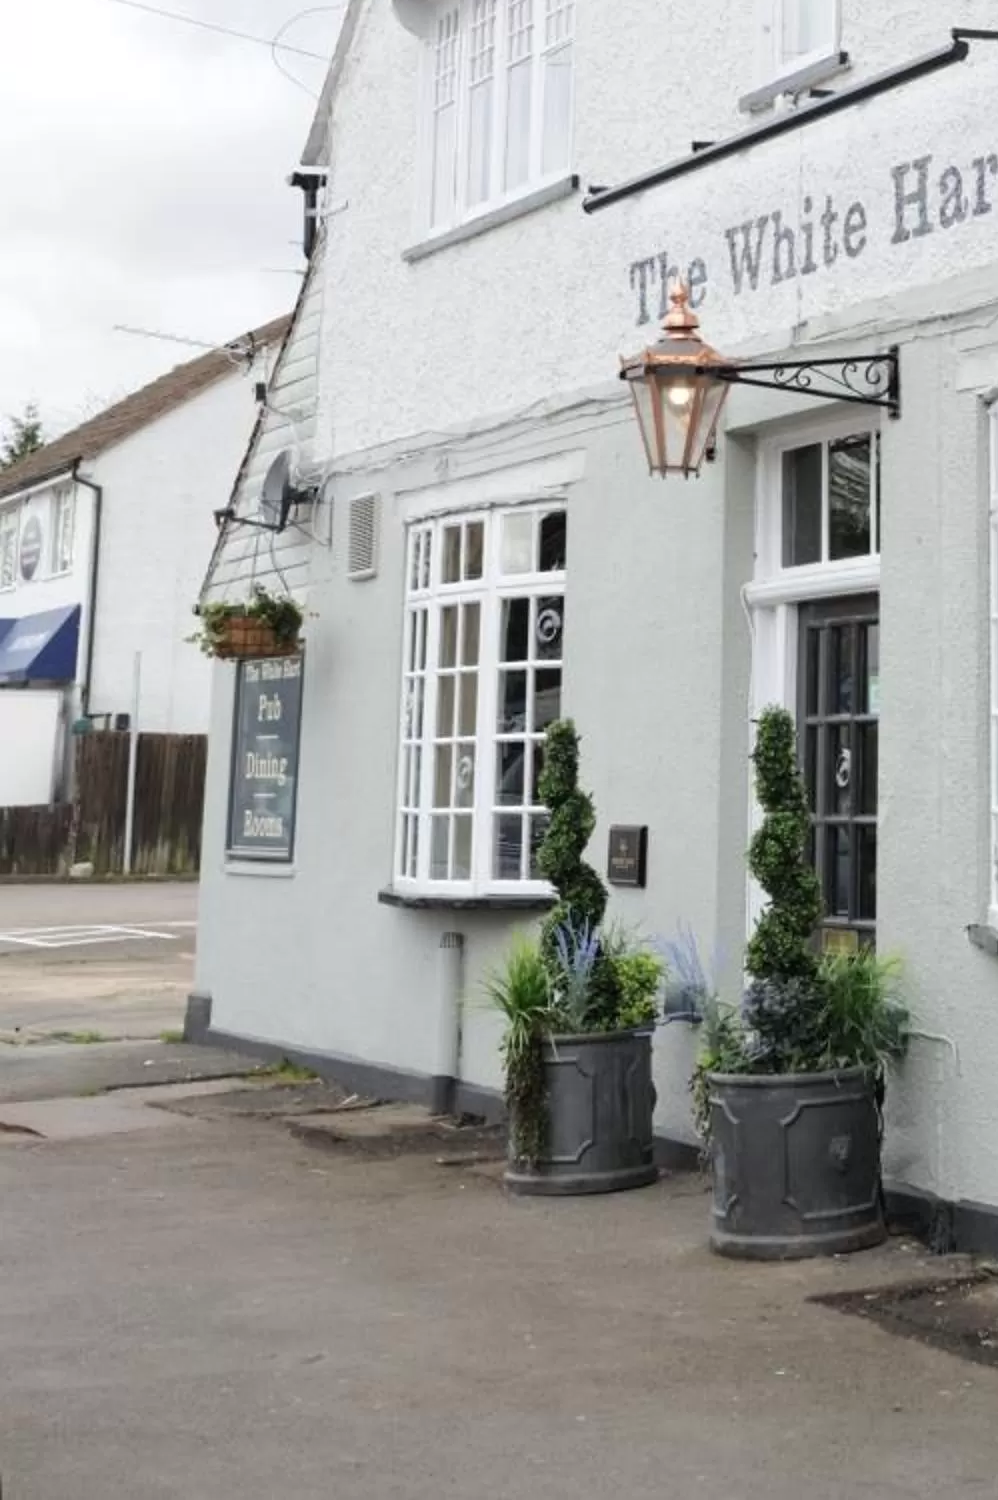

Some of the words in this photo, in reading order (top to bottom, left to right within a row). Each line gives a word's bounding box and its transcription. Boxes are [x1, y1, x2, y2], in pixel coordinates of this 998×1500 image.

[629, 250, 709, 327] The
[724, 195, 868, 296] White
[257, 693, 281, 722] Pub
[245, 753, 288, 786] Dining
[244, 809, 283, 837] Rooms
